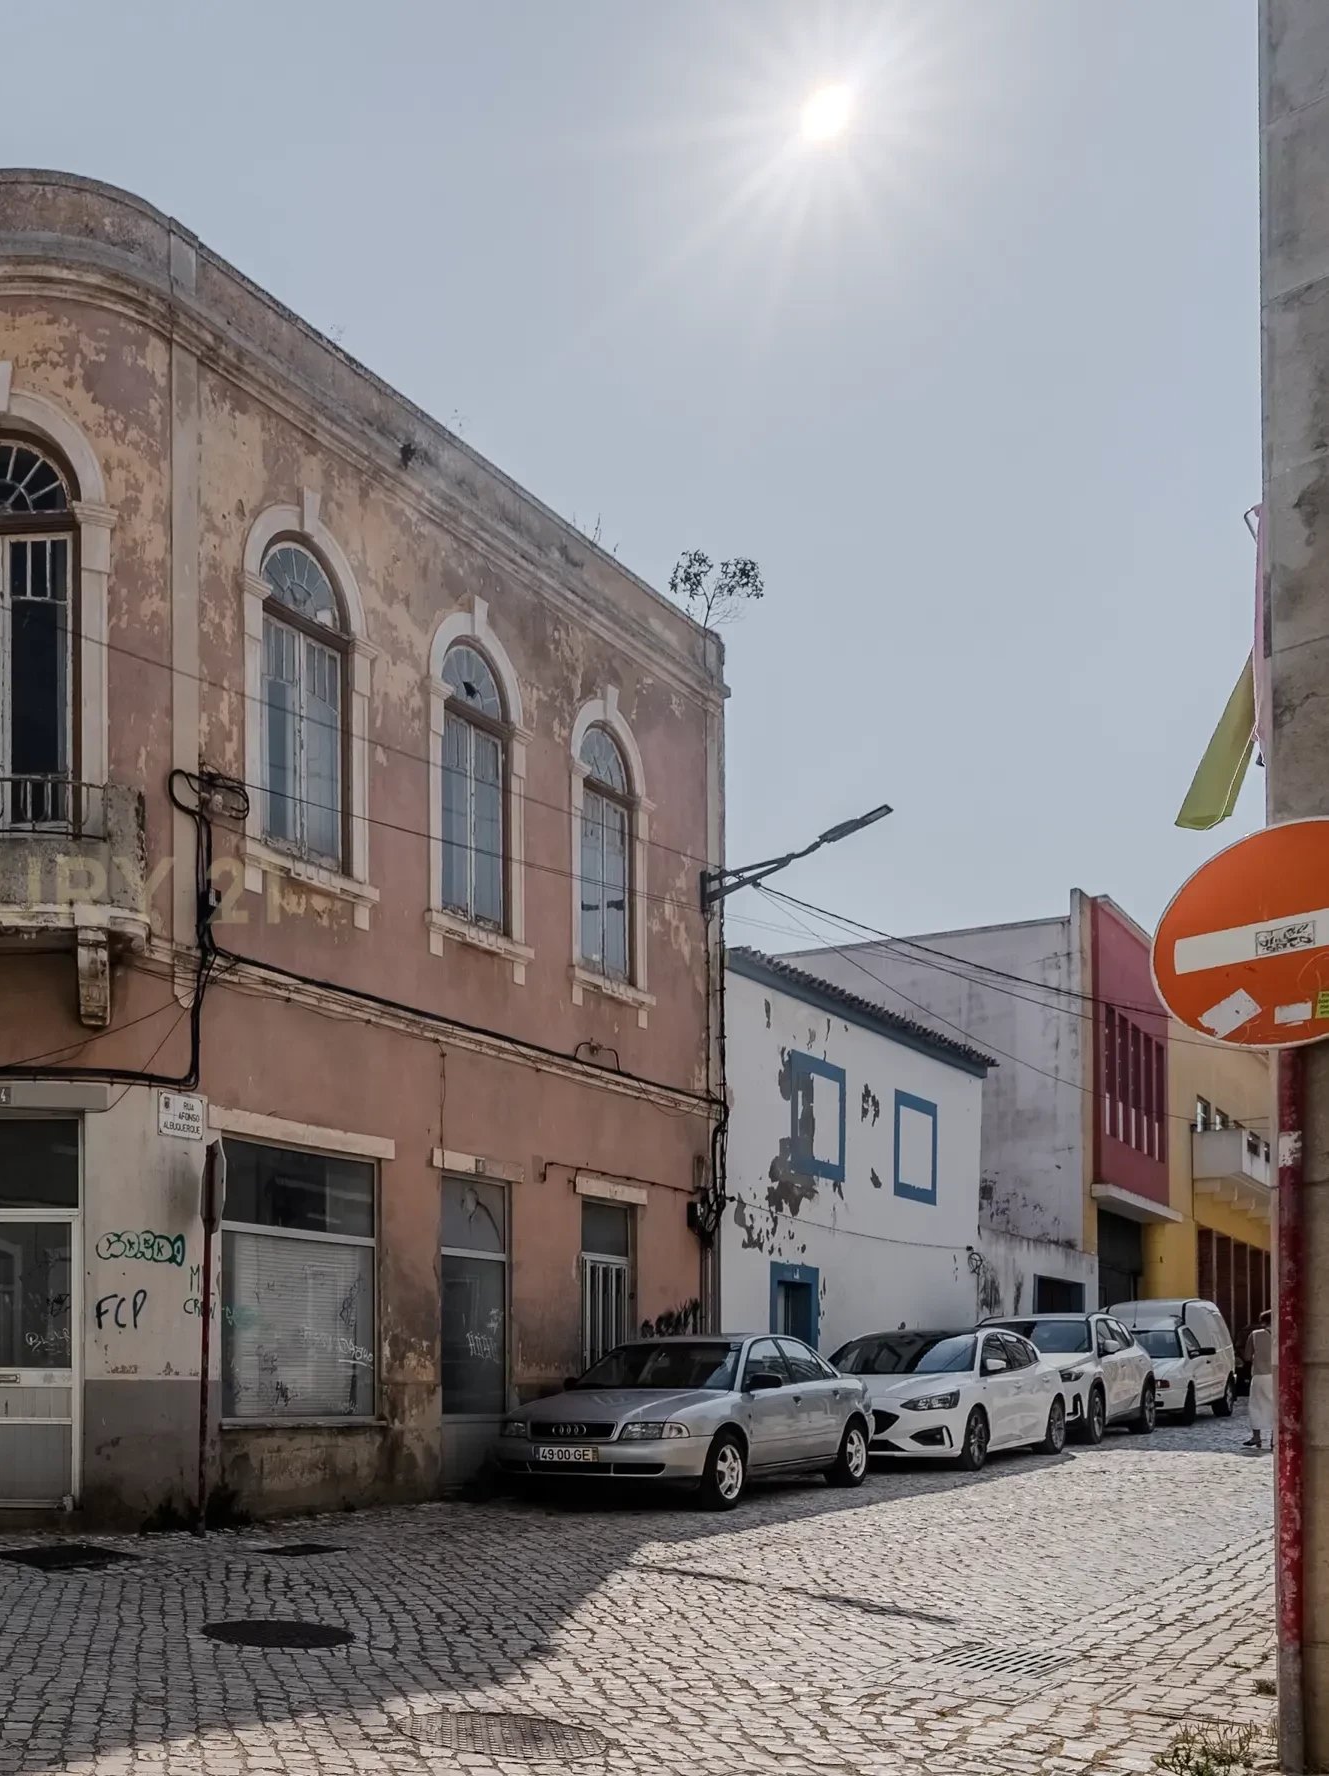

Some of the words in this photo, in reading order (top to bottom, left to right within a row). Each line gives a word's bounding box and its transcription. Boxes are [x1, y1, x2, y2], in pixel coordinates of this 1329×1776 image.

[183, 1101, 195, 1111] RUA
[178, 1111, 200, 1123] AFONSO
[163, 1120, 201, 1135] ALBUQUERQUE
[96, 1288, 148, 1329] FCP
